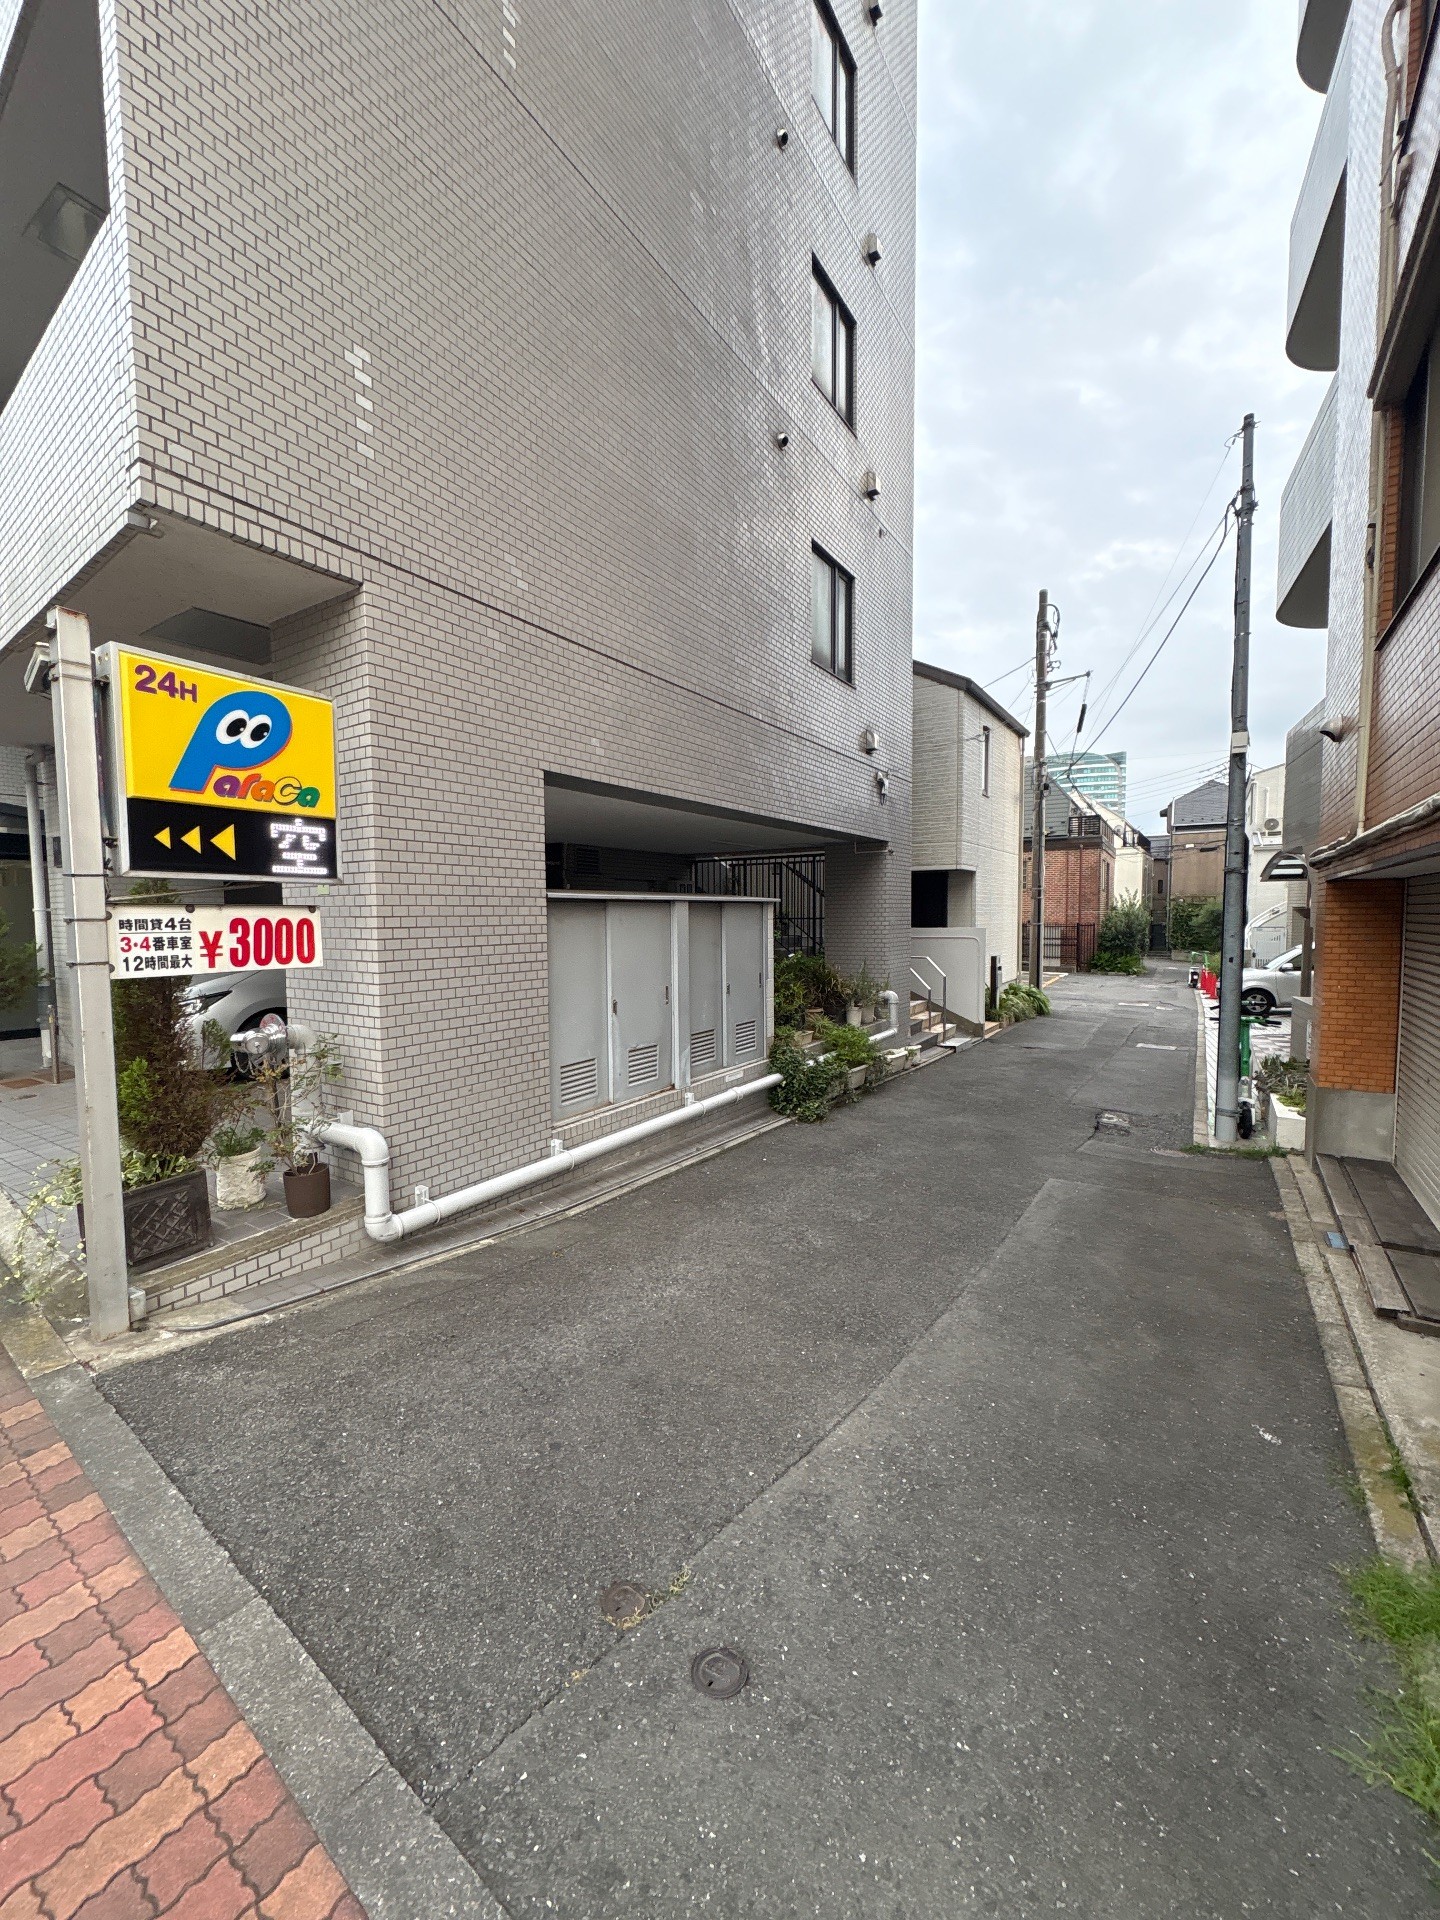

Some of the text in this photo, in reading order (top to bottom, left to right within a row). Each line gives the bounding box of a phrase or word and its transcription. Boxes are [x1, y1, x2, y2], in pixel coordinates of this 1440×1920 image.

[134, 664, 198, 704] 24H
[270, 818, 328, 875] 空
[118, 917, 192, 932] 時間貸4台
[199, 917, 316, 969] ¥3000
[122, 954, 193, 972] 12時間最大
